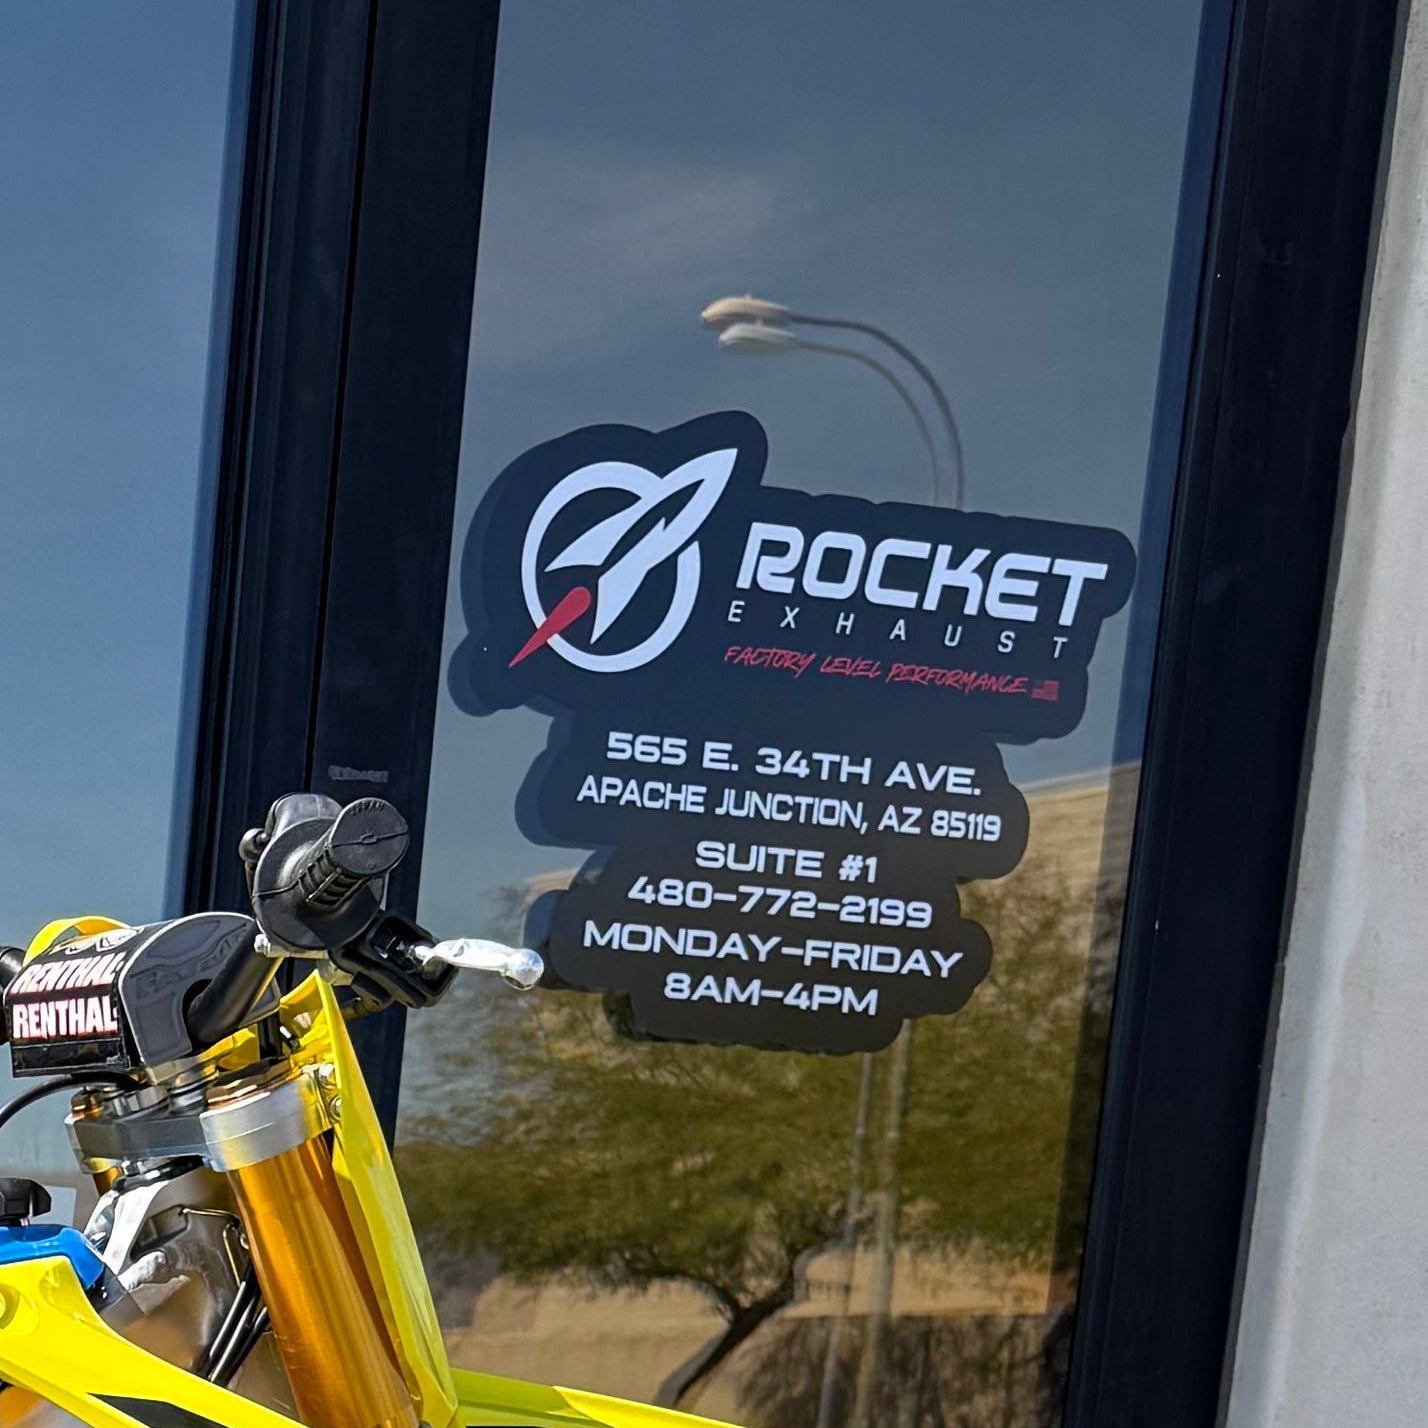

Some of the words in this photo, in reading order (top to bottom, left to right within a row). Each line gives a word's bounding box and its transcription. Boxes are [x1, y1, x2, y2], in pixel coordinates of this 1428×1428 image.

[736, 521, 1108, 626] ROCKET
[726, 600, 1069, 658] EXHAUST
[724, 646, 811, 677] FACTORY
[819, 655, 881, 679] LEVEL
[885, 663, 1028, 694] PERFORMANCE
[607, 731, 687, 766] 565
[702, 741, 740, 771] E.
[755, 747, 872, 785] 34TH
[884, 761, 981, 796] AVE.
[577, 775, 707, 814] APACHE
[715, 788, 868, 835] JUNCTION,
[878, 804, 923, 834] AZ
[930, 809, 1002, 842] 85119
[695, 841, 825, 878] SUITE
[838, 854, 877, 883] #1
[627, 876, 932, 928] 480-772-2199
[9, 951, 127, 994] RENTHAL
[583, 920, 963, 978] MONDAY-FRIDAY
[12, 995, 118, 1039] RENTHAL
[664, 972, 878, 1016] 8AM-4PM
